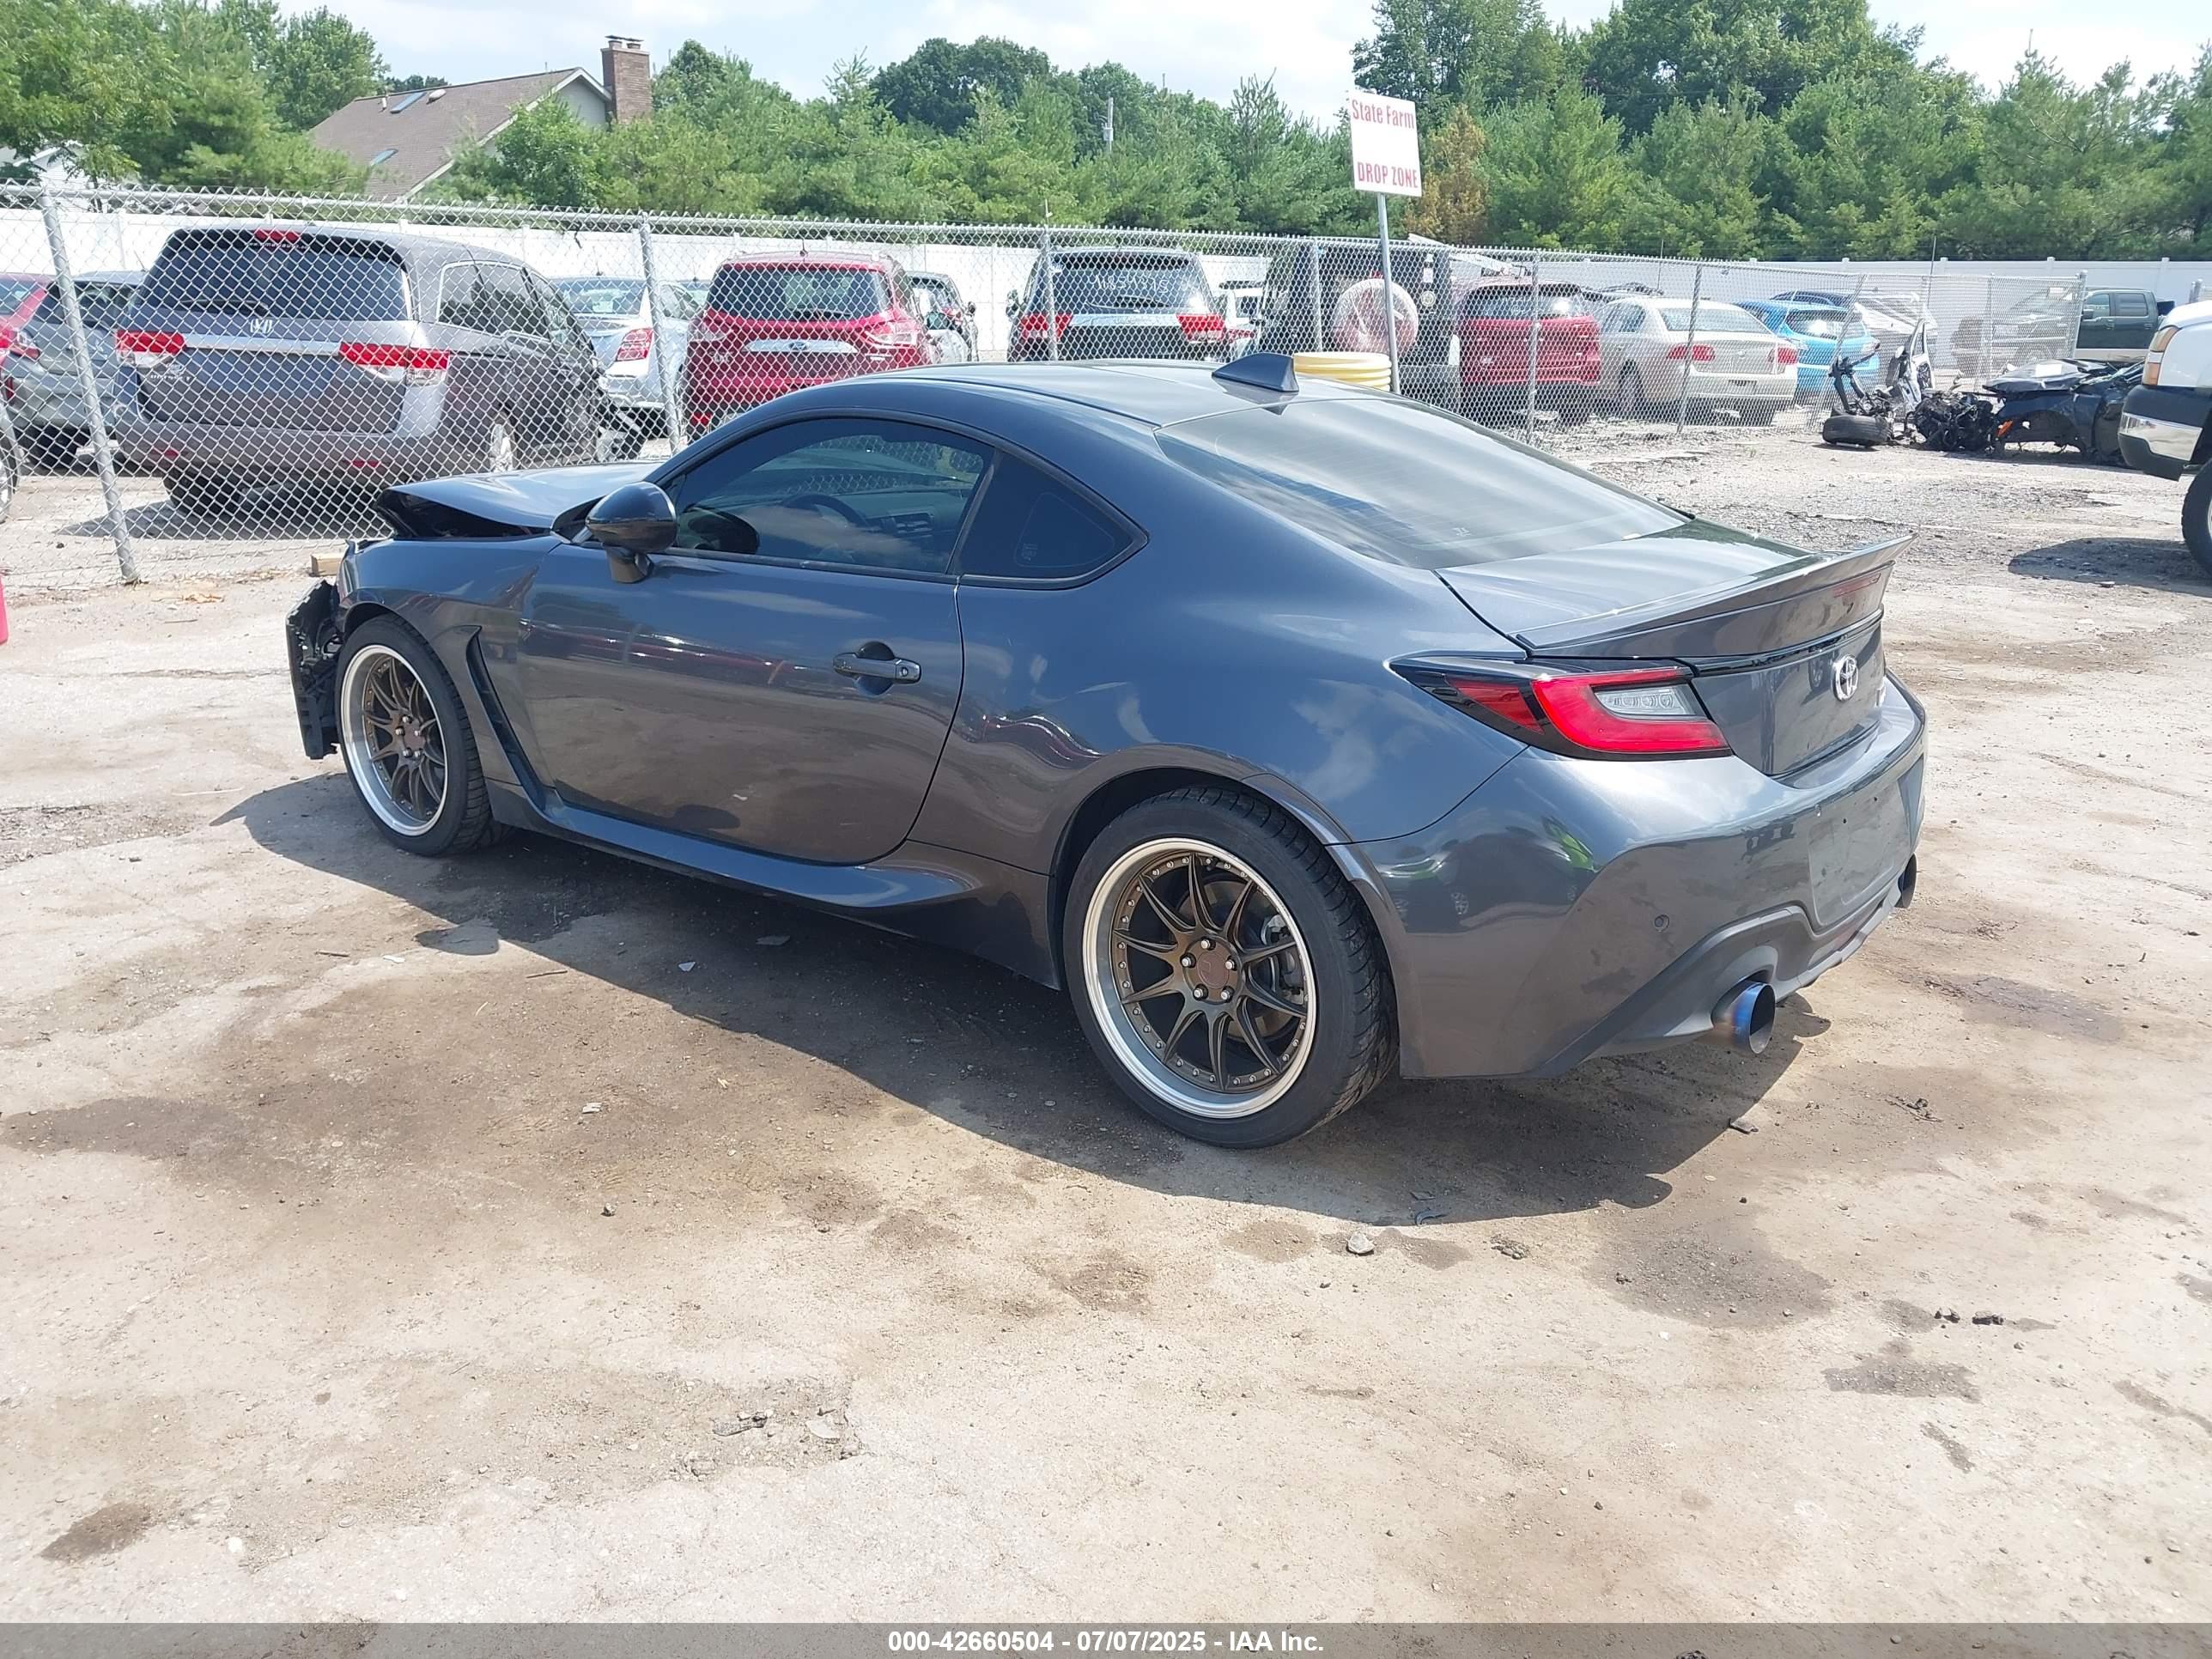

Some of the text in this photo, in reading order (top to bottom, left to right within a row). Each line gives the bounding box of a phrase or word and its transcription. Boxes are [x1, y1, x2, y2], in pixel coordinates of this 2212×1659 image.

[1352, 99, 1415, 130] State Farm
[1357, 161, 1419, 189] DROP ZONE
